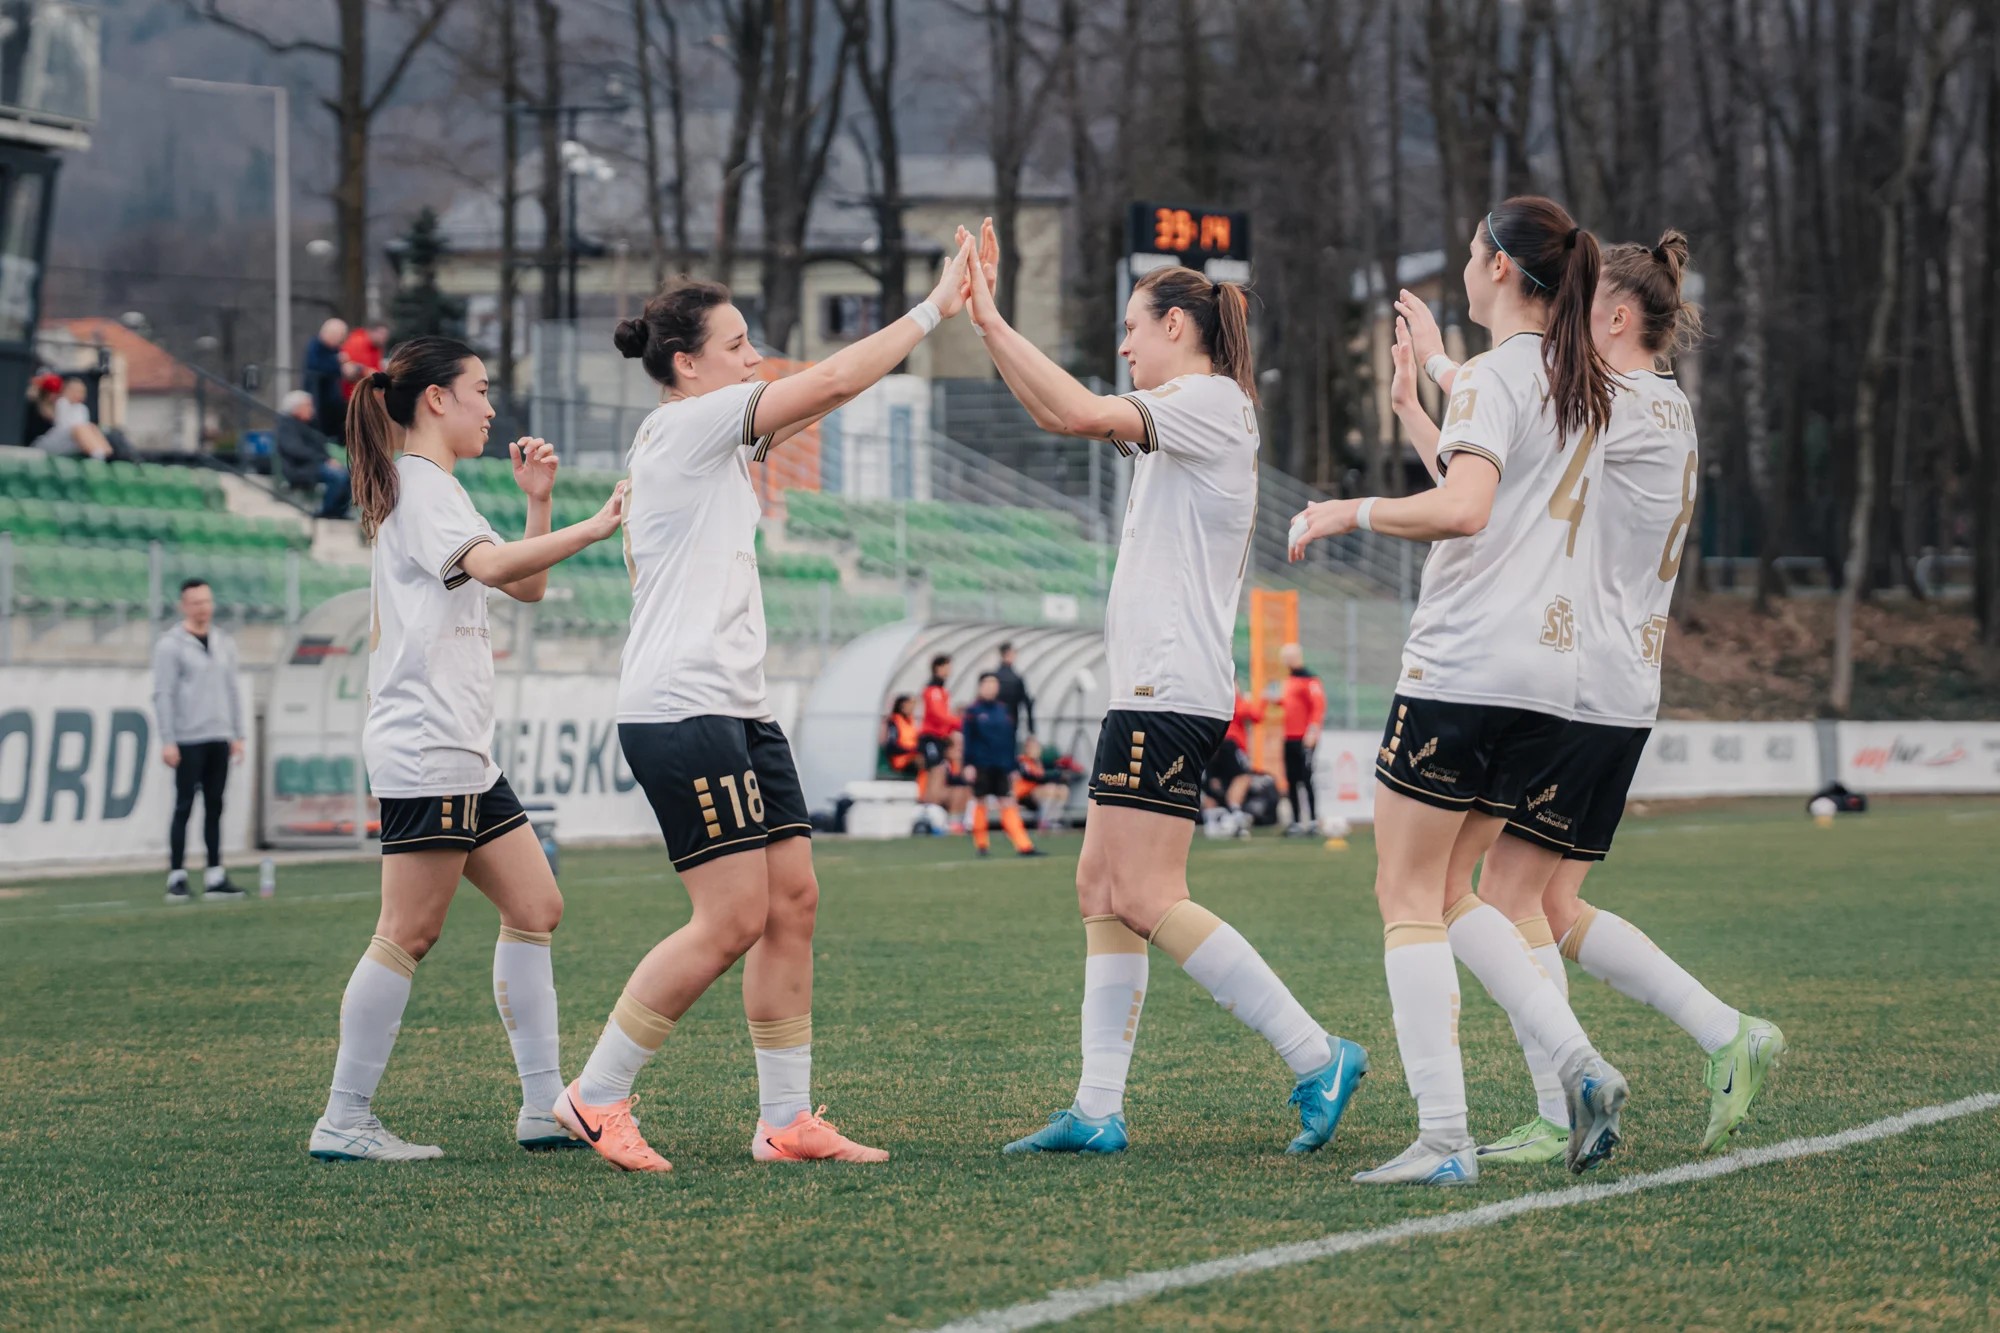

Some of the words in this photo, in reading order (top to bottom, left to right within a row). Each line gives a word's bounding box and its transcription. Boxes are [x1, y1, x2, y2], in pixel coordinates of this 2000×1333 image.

[1657, 450, 1697, 582] 8
[455, 626, 475, 637] PORT
[1540, 595, 1574, 652] STS
[0, 709, 149, 825] ORD
[719, 769, 765, 829] 18
